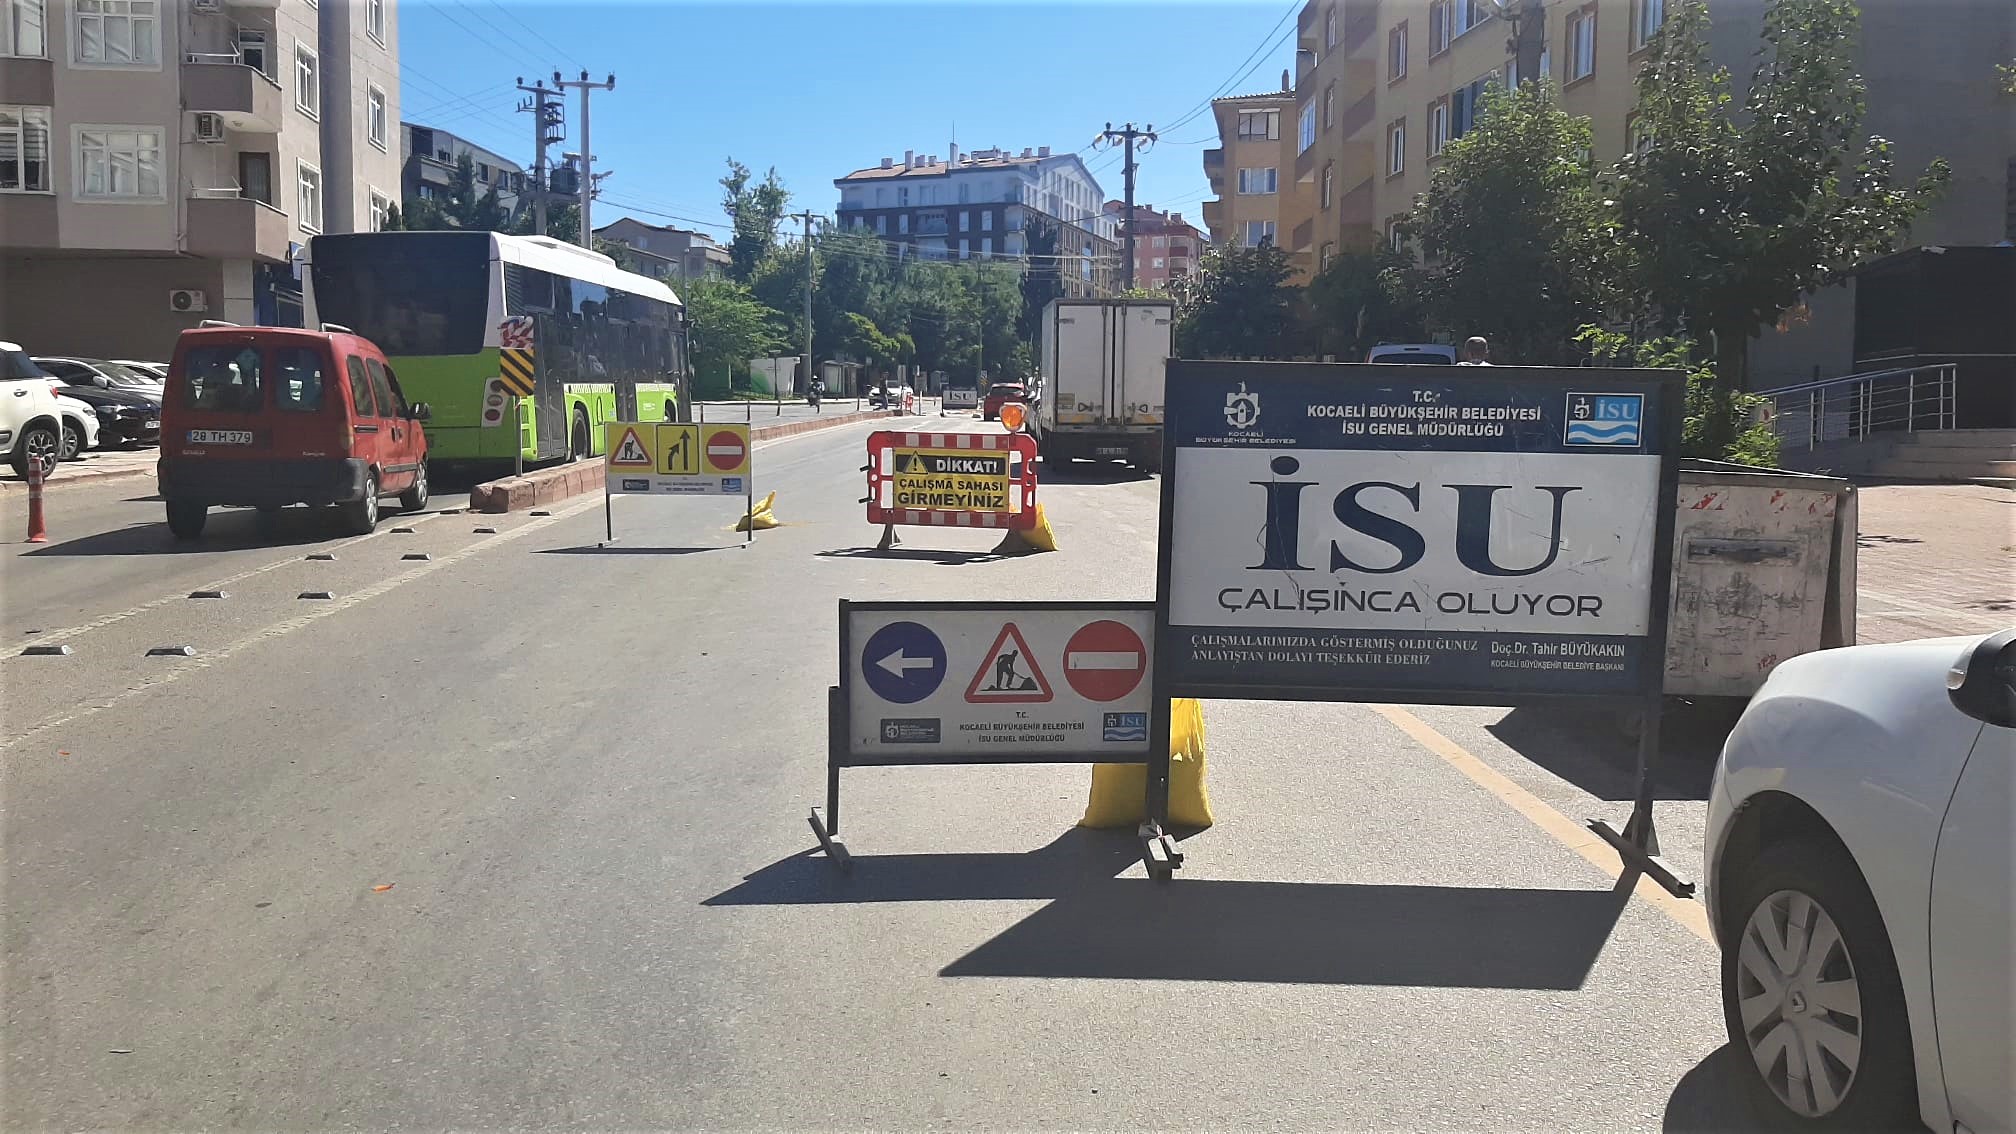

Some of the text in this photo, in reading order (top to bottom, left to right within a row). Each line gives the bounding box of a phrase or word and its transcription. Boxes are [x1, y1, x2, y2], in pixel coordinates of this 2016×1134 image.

[1413, 391, 1436, 402] T.C.
[1307, 403, 1541, 421] KOCAELİ BÜYÜKŞEHİR BELEDİYESİ
[1598, 399, 1638, 419] İSU
[1342, 420, 1504, 436] İSU GENEL MÜDÜRLÜĞÜ
[192, 431, 251, 443] 28 TH 379
[936, 457, 998, 473] DİKKAT!
[899, 479, 1003, 492] ÇALIŞMA SAHASI
[897, 490, 1004, 508] GİRMEYİNİZ
[1245, 455, 1583, 577] İSU
[1436, 592, 1603, 617] OLUYOR
[1191, 635, 1317, 647] ÇALIŞMALARIMIZDA
[1399, 637, 1479, 650] OLDUĞUNUZ
[1560, 641, 1625, 657] BÜYÜKAKIN
[1191, 650, 1431, 666] ANLAYIŞTAN DOLAYI TEŞEKKÜR EDERİZ
